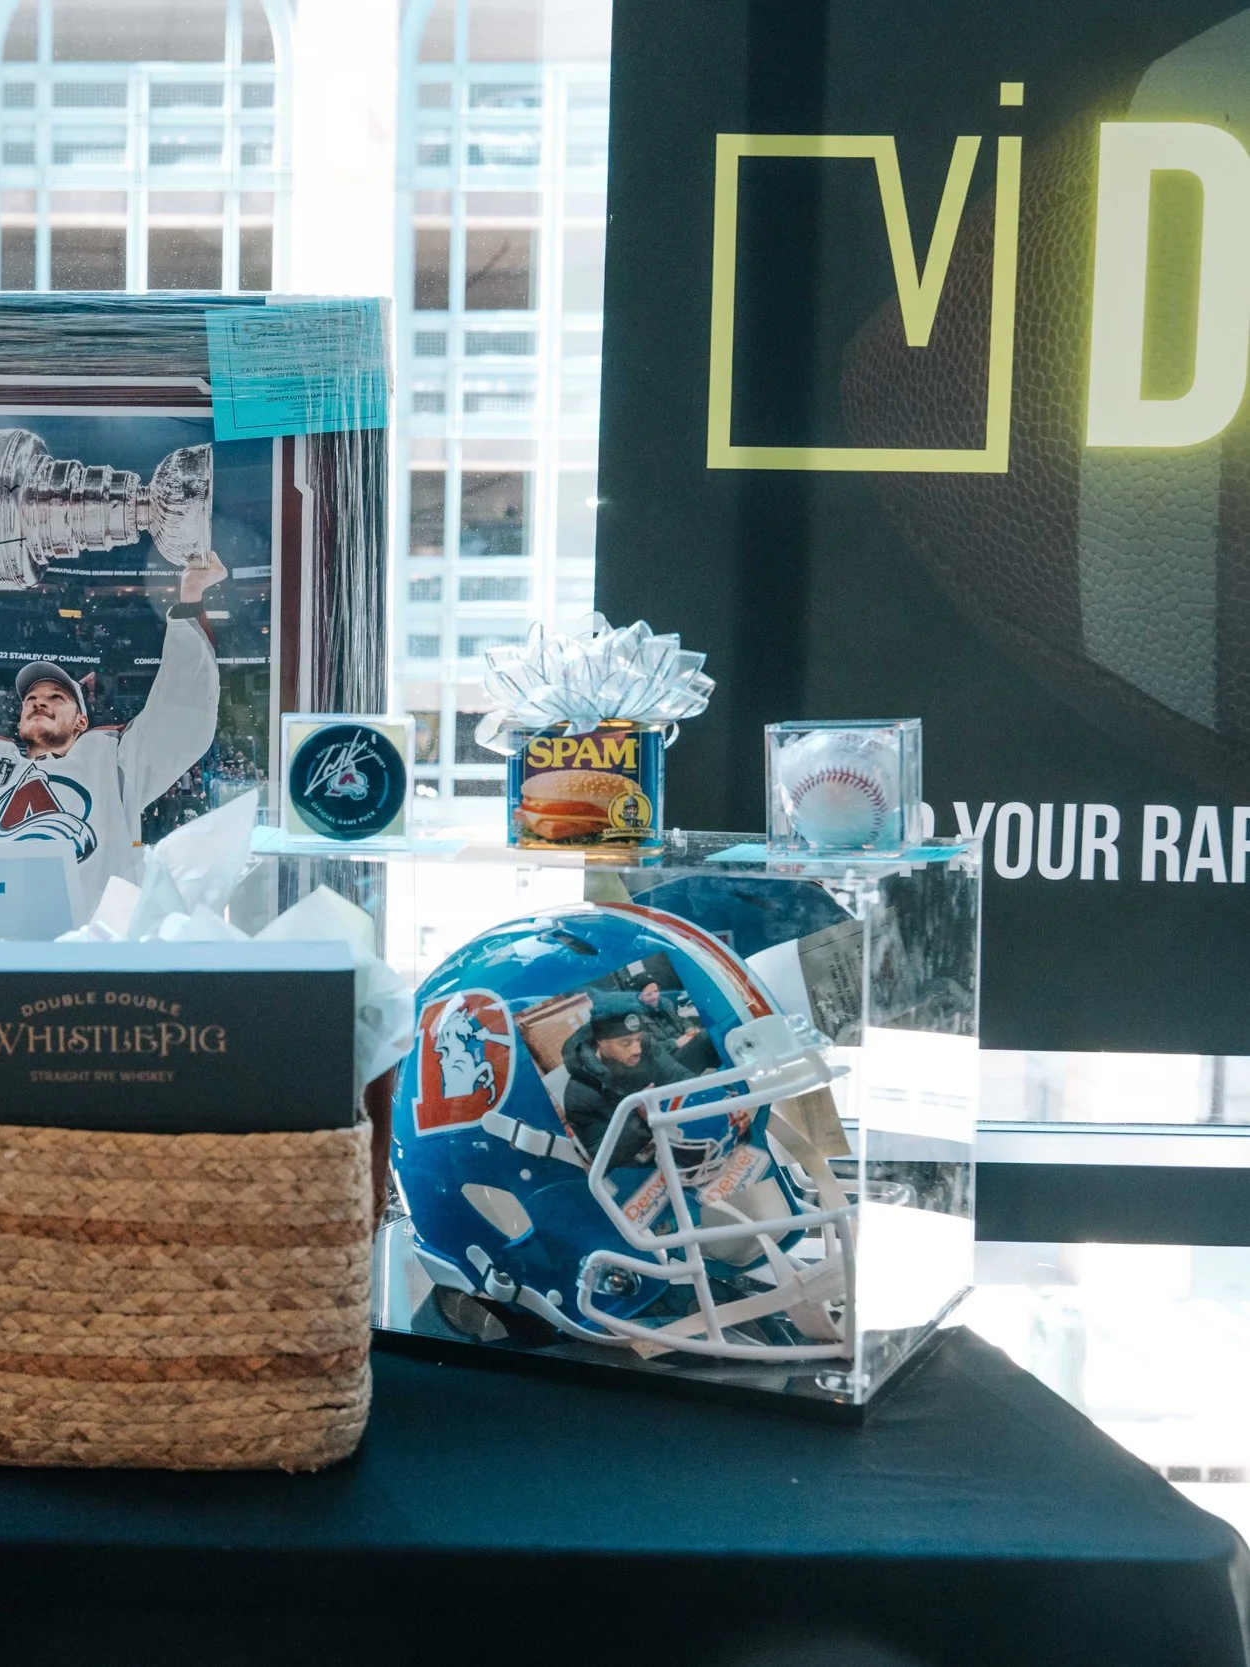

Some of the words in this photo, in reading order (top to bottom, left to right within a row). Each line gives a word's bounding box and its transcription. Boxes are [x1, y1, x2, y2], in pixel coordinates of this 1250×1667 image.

[9, 652, 42, 661] STANLEY
[42, 653, 58, 662] CUP
[58, 654, 101, 664] CHAMPIONS
[527, 736, 637, 769] SPAM
[311, 801, 336, 823] OFFICIAL
[358, 810, 376, 823] PUCK
[952, 801, 1120, 881] YOUR
[20, 991, 97, 1018] DOUBLE
[104, 991, 182, 1017] DOUBLE
[30, 1070, 90, 1083] STRAIGHT
[93, 1070, 116, 1082] RYE
[119, 1070, 174, 1083] WHISKEY
